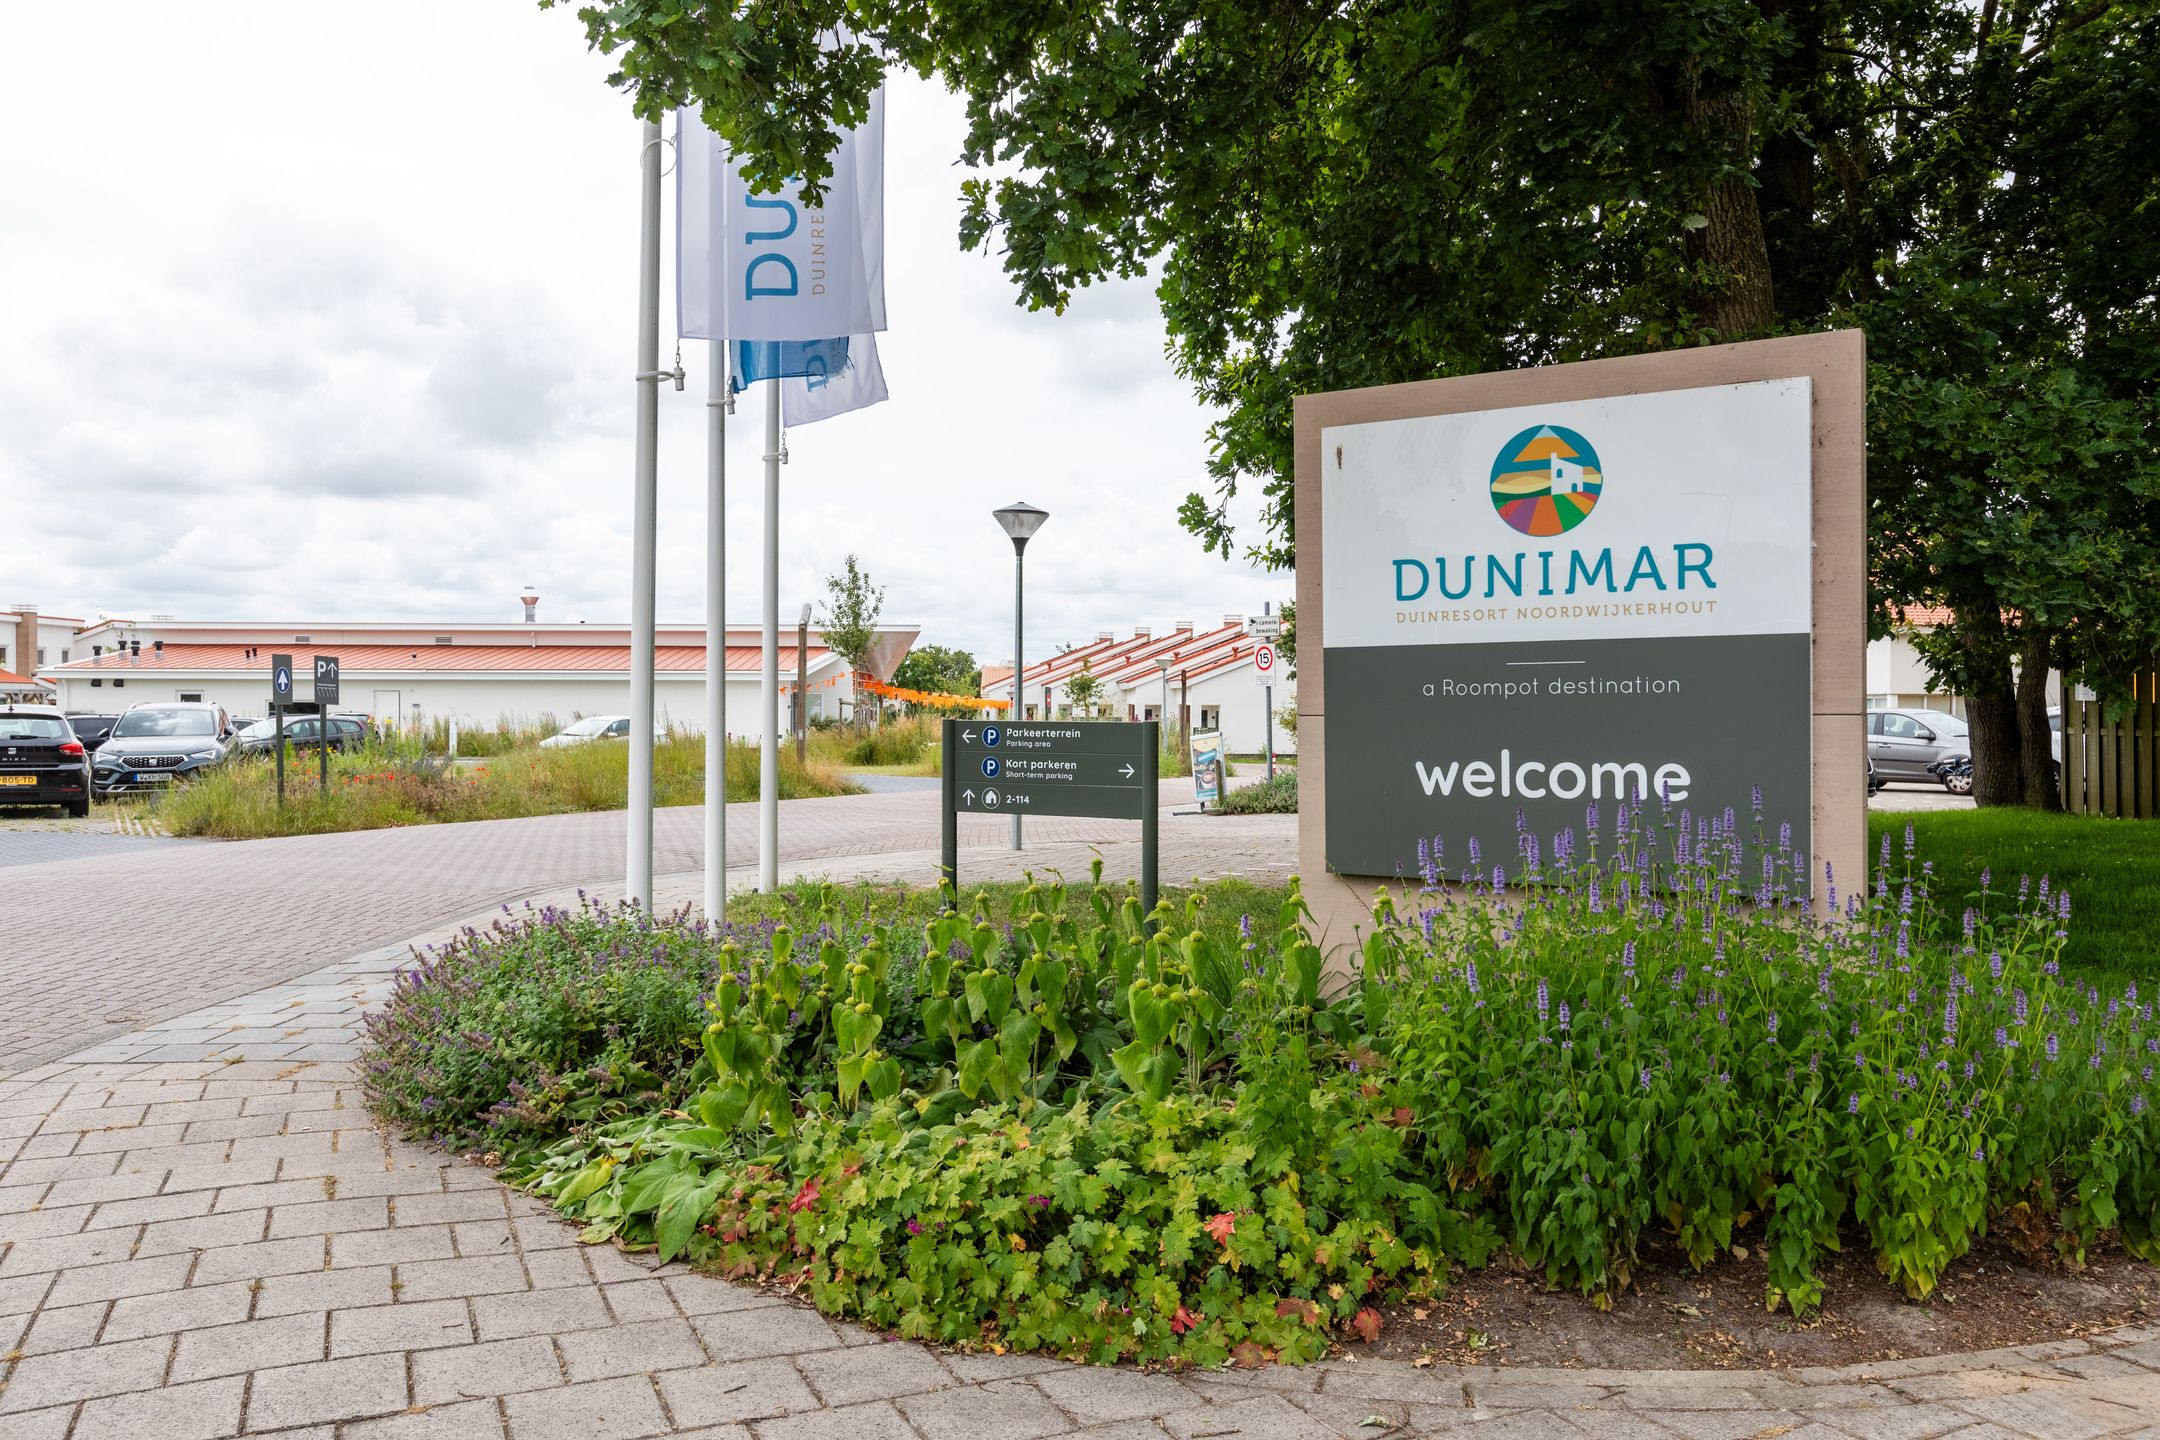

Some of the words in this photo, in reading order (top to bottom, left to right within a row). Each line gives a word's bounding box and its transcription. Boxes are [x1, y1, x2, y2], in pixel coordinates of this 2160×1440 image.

[745, 172, 798, 301] DU
[1392, 542, 1717, 602] DUNIMAR
[1396, 608, 1508, 624] DUINRESORT
[1516, 600, 1718, 621] NOORDWIJKERHOUT
[1259, 653, 1270, 664] 15
[317, 661, 327, 678] P
[1422, 683, 1434, 697] a
[1442, 678, 1539, 700] Roompot
[1548, 676, 1680, 696] destination
[987, 729, 997, 744] P
[1006, 728, 1081, 738] Parkeerterrein
[1006, 740, 1033, 748] Parking
[986, 760, 996, 774] P
[1005, 759, 1027, 769] Kort
[1030, 760, 1077, 770] parkeren
[1005, 771, 1044, 779] Short-term
[1045, 772, 1073, 781] parking
[1415, 748, 1691, 802] welcome
[1006, 794, 1030, 804] 2-114
